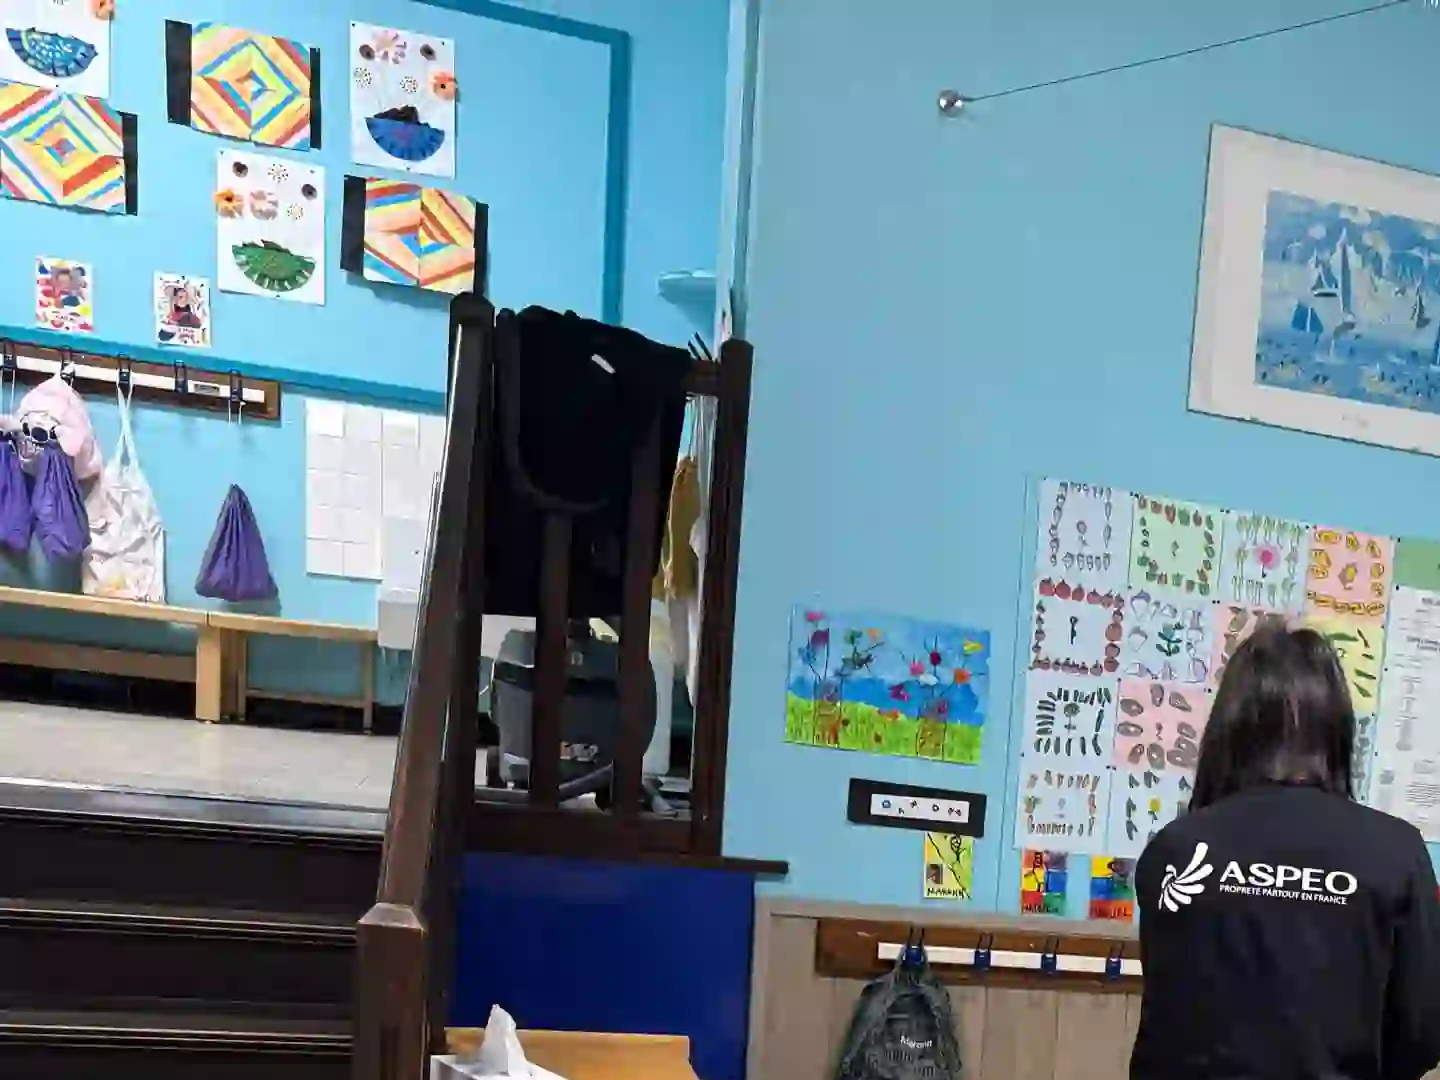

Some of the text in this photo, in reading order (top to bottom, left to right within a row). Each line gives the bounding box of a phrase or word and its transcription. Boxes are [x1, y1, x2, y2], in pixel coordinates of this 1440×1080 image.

[1219, 860, 1359, 896] ASPEO
[1262, 888, 1301, 900] PARTOUT
[1301, 891, 1313, 901] EN
[1313, 893, 1349, 905] FRANCE
